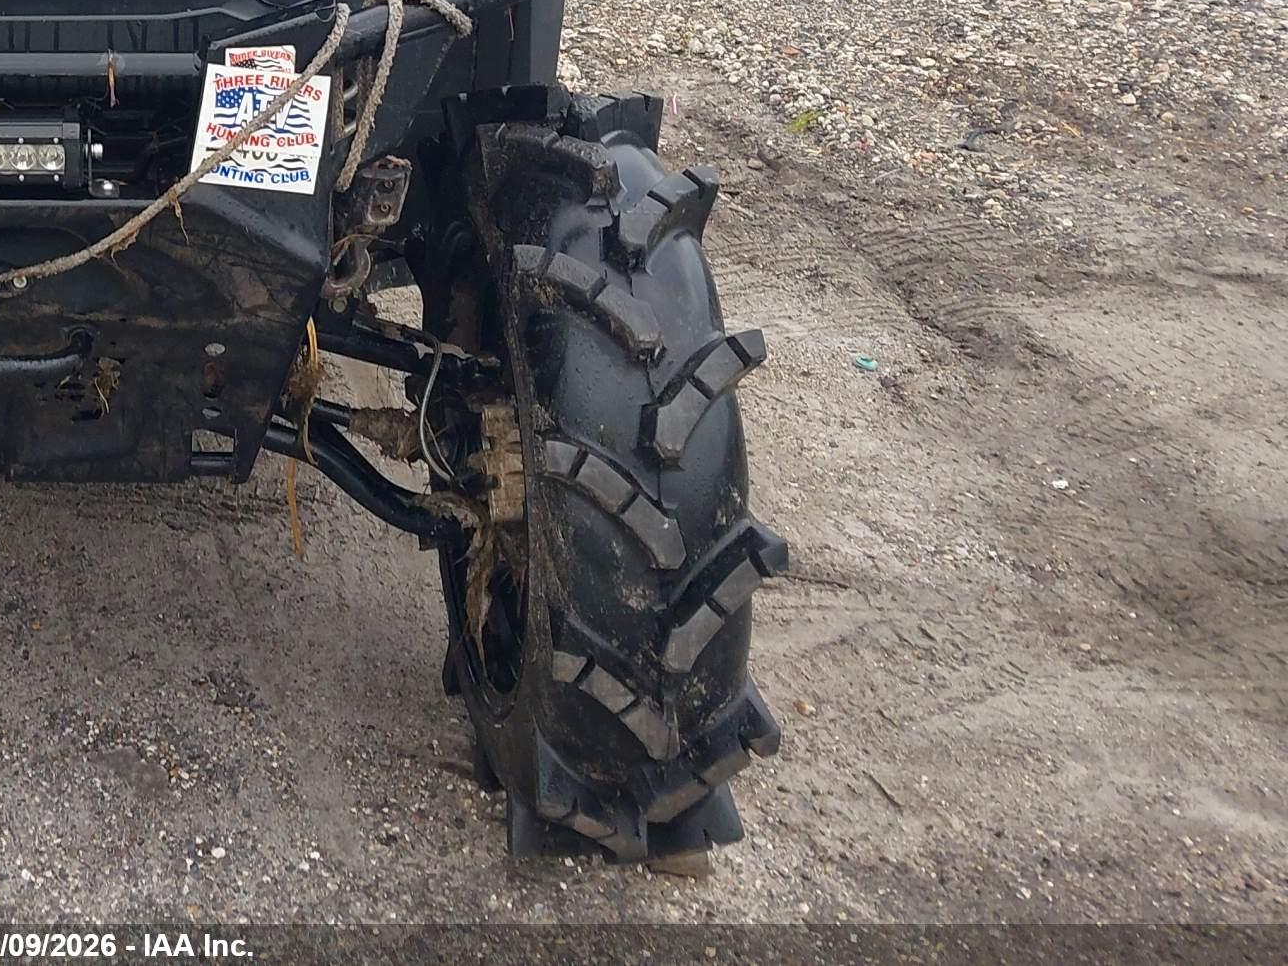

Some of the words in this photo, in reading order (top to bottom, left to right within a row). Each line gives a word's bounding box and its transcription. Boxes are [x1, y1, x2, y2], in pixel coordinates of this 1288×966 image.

[213, 74, 265, 91] THREE
[270, 75, 323, 101] RIVRS
[206, 123, 270, 148] HUNING
[276, 133, 315, 148] CLUB
[210, 165, 263, 184] UNTING
[271, 170, 310, 184] CLUB
